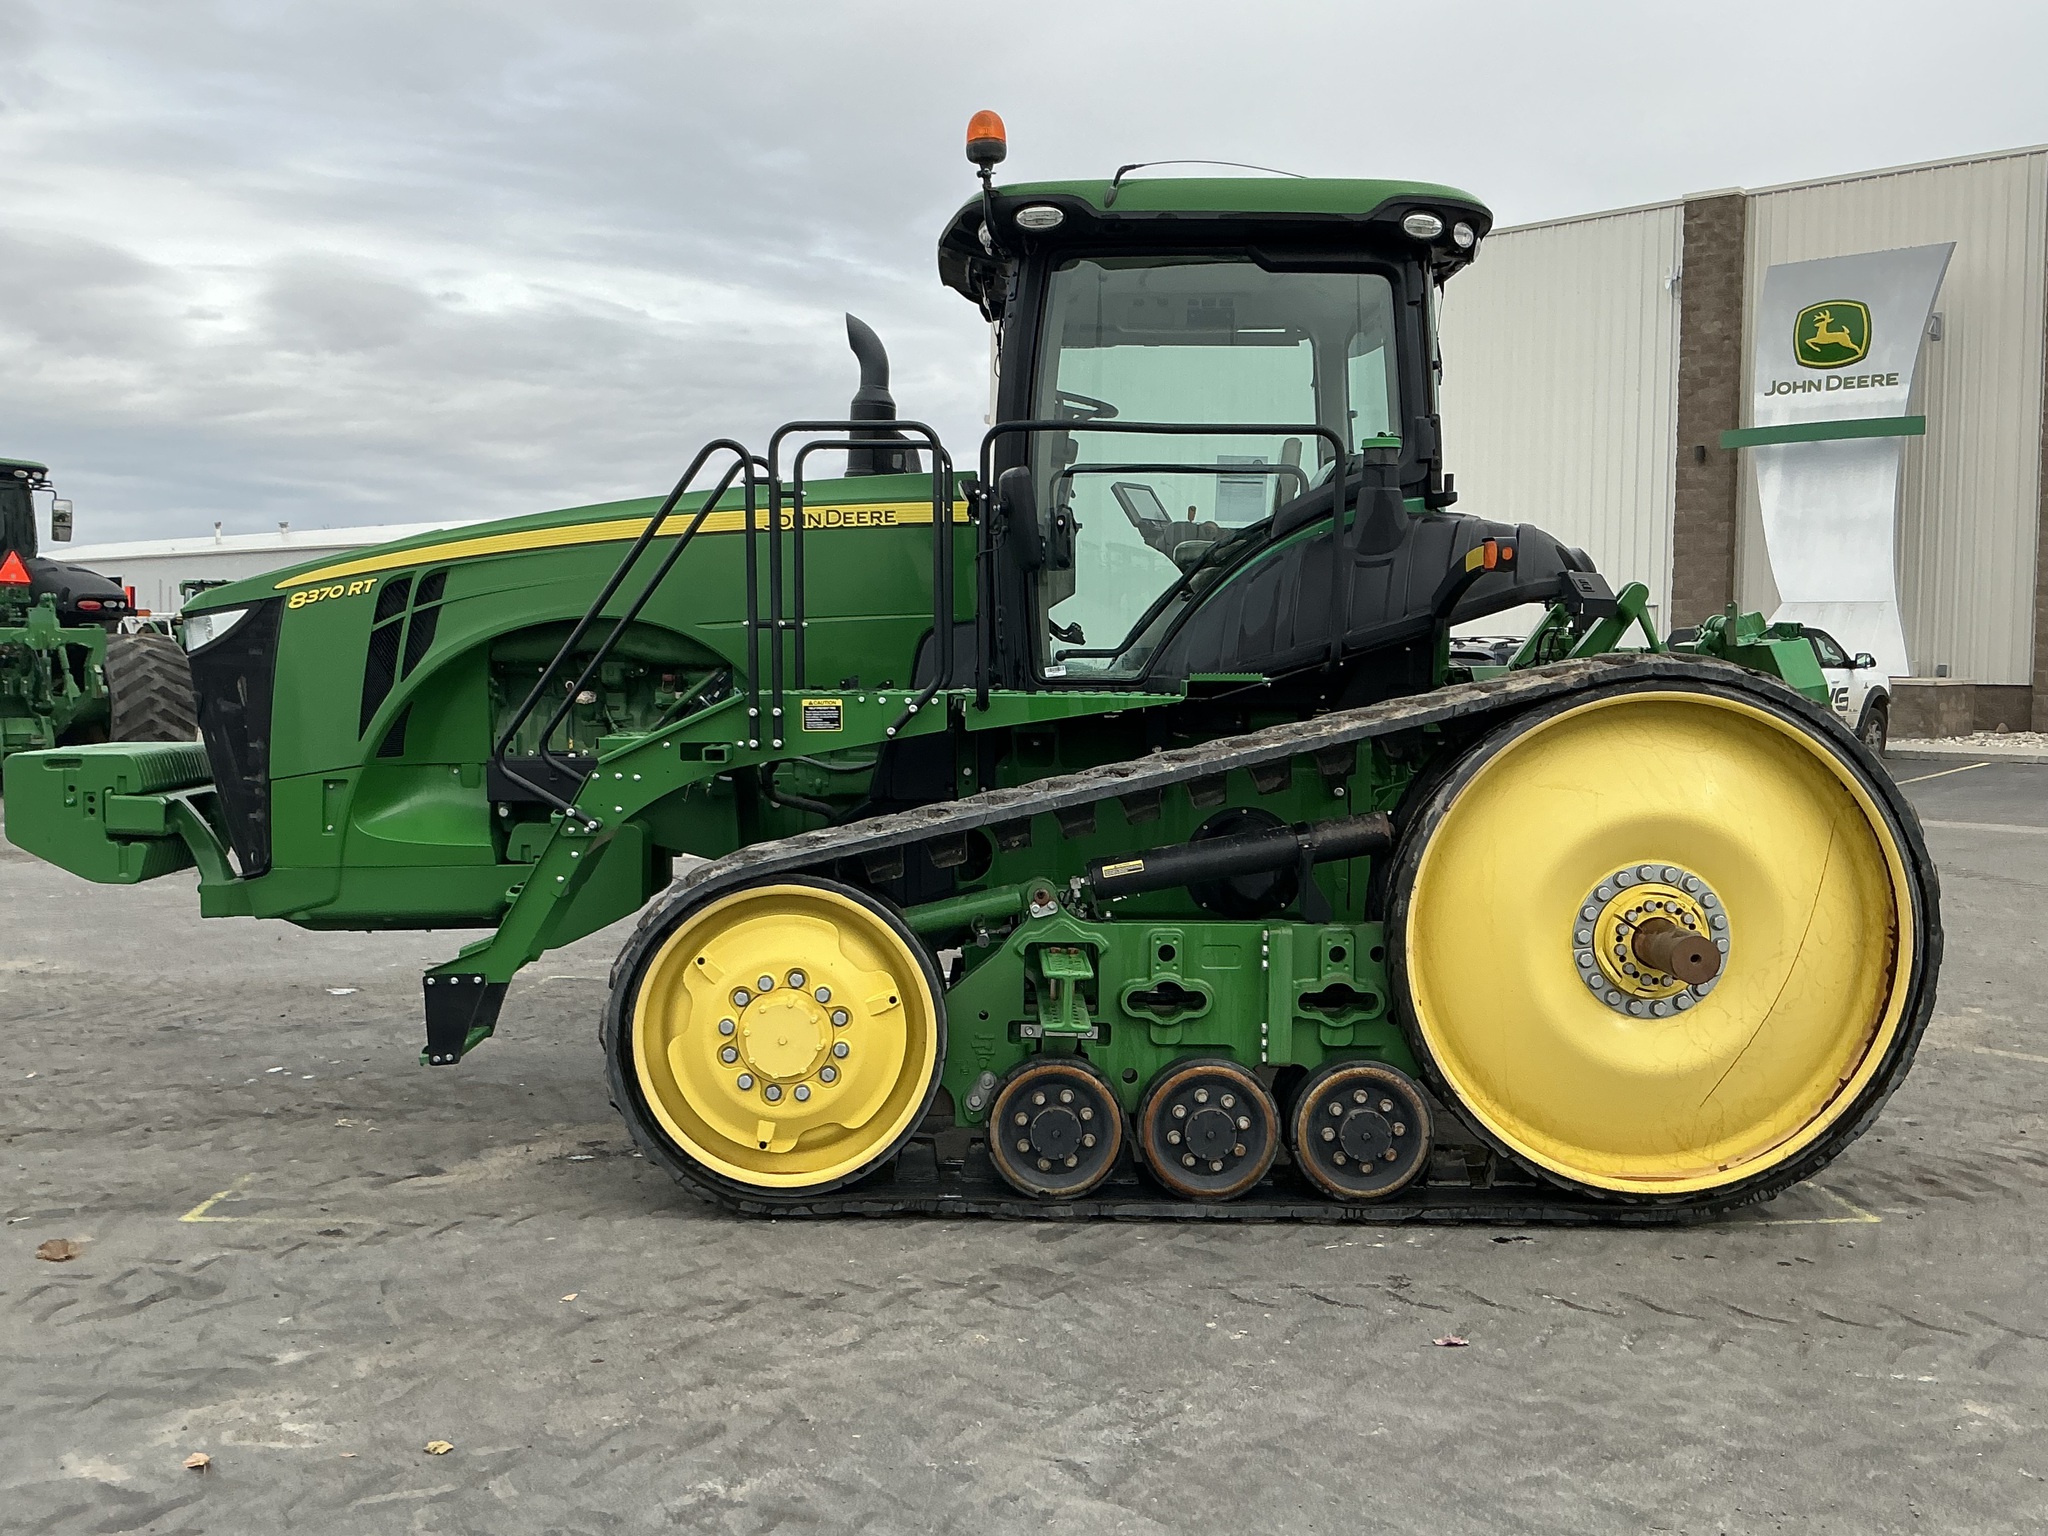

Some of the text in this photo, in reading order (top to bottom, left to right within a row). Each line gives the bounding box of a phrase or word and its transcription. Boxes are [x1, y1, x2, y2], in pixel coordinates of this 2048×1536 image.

[1764, 372, 1899, 396] JOHN DEERE
[764, 510, 897, 529] ON DEERE
[288, 578, 377, 609] 8370 RT
